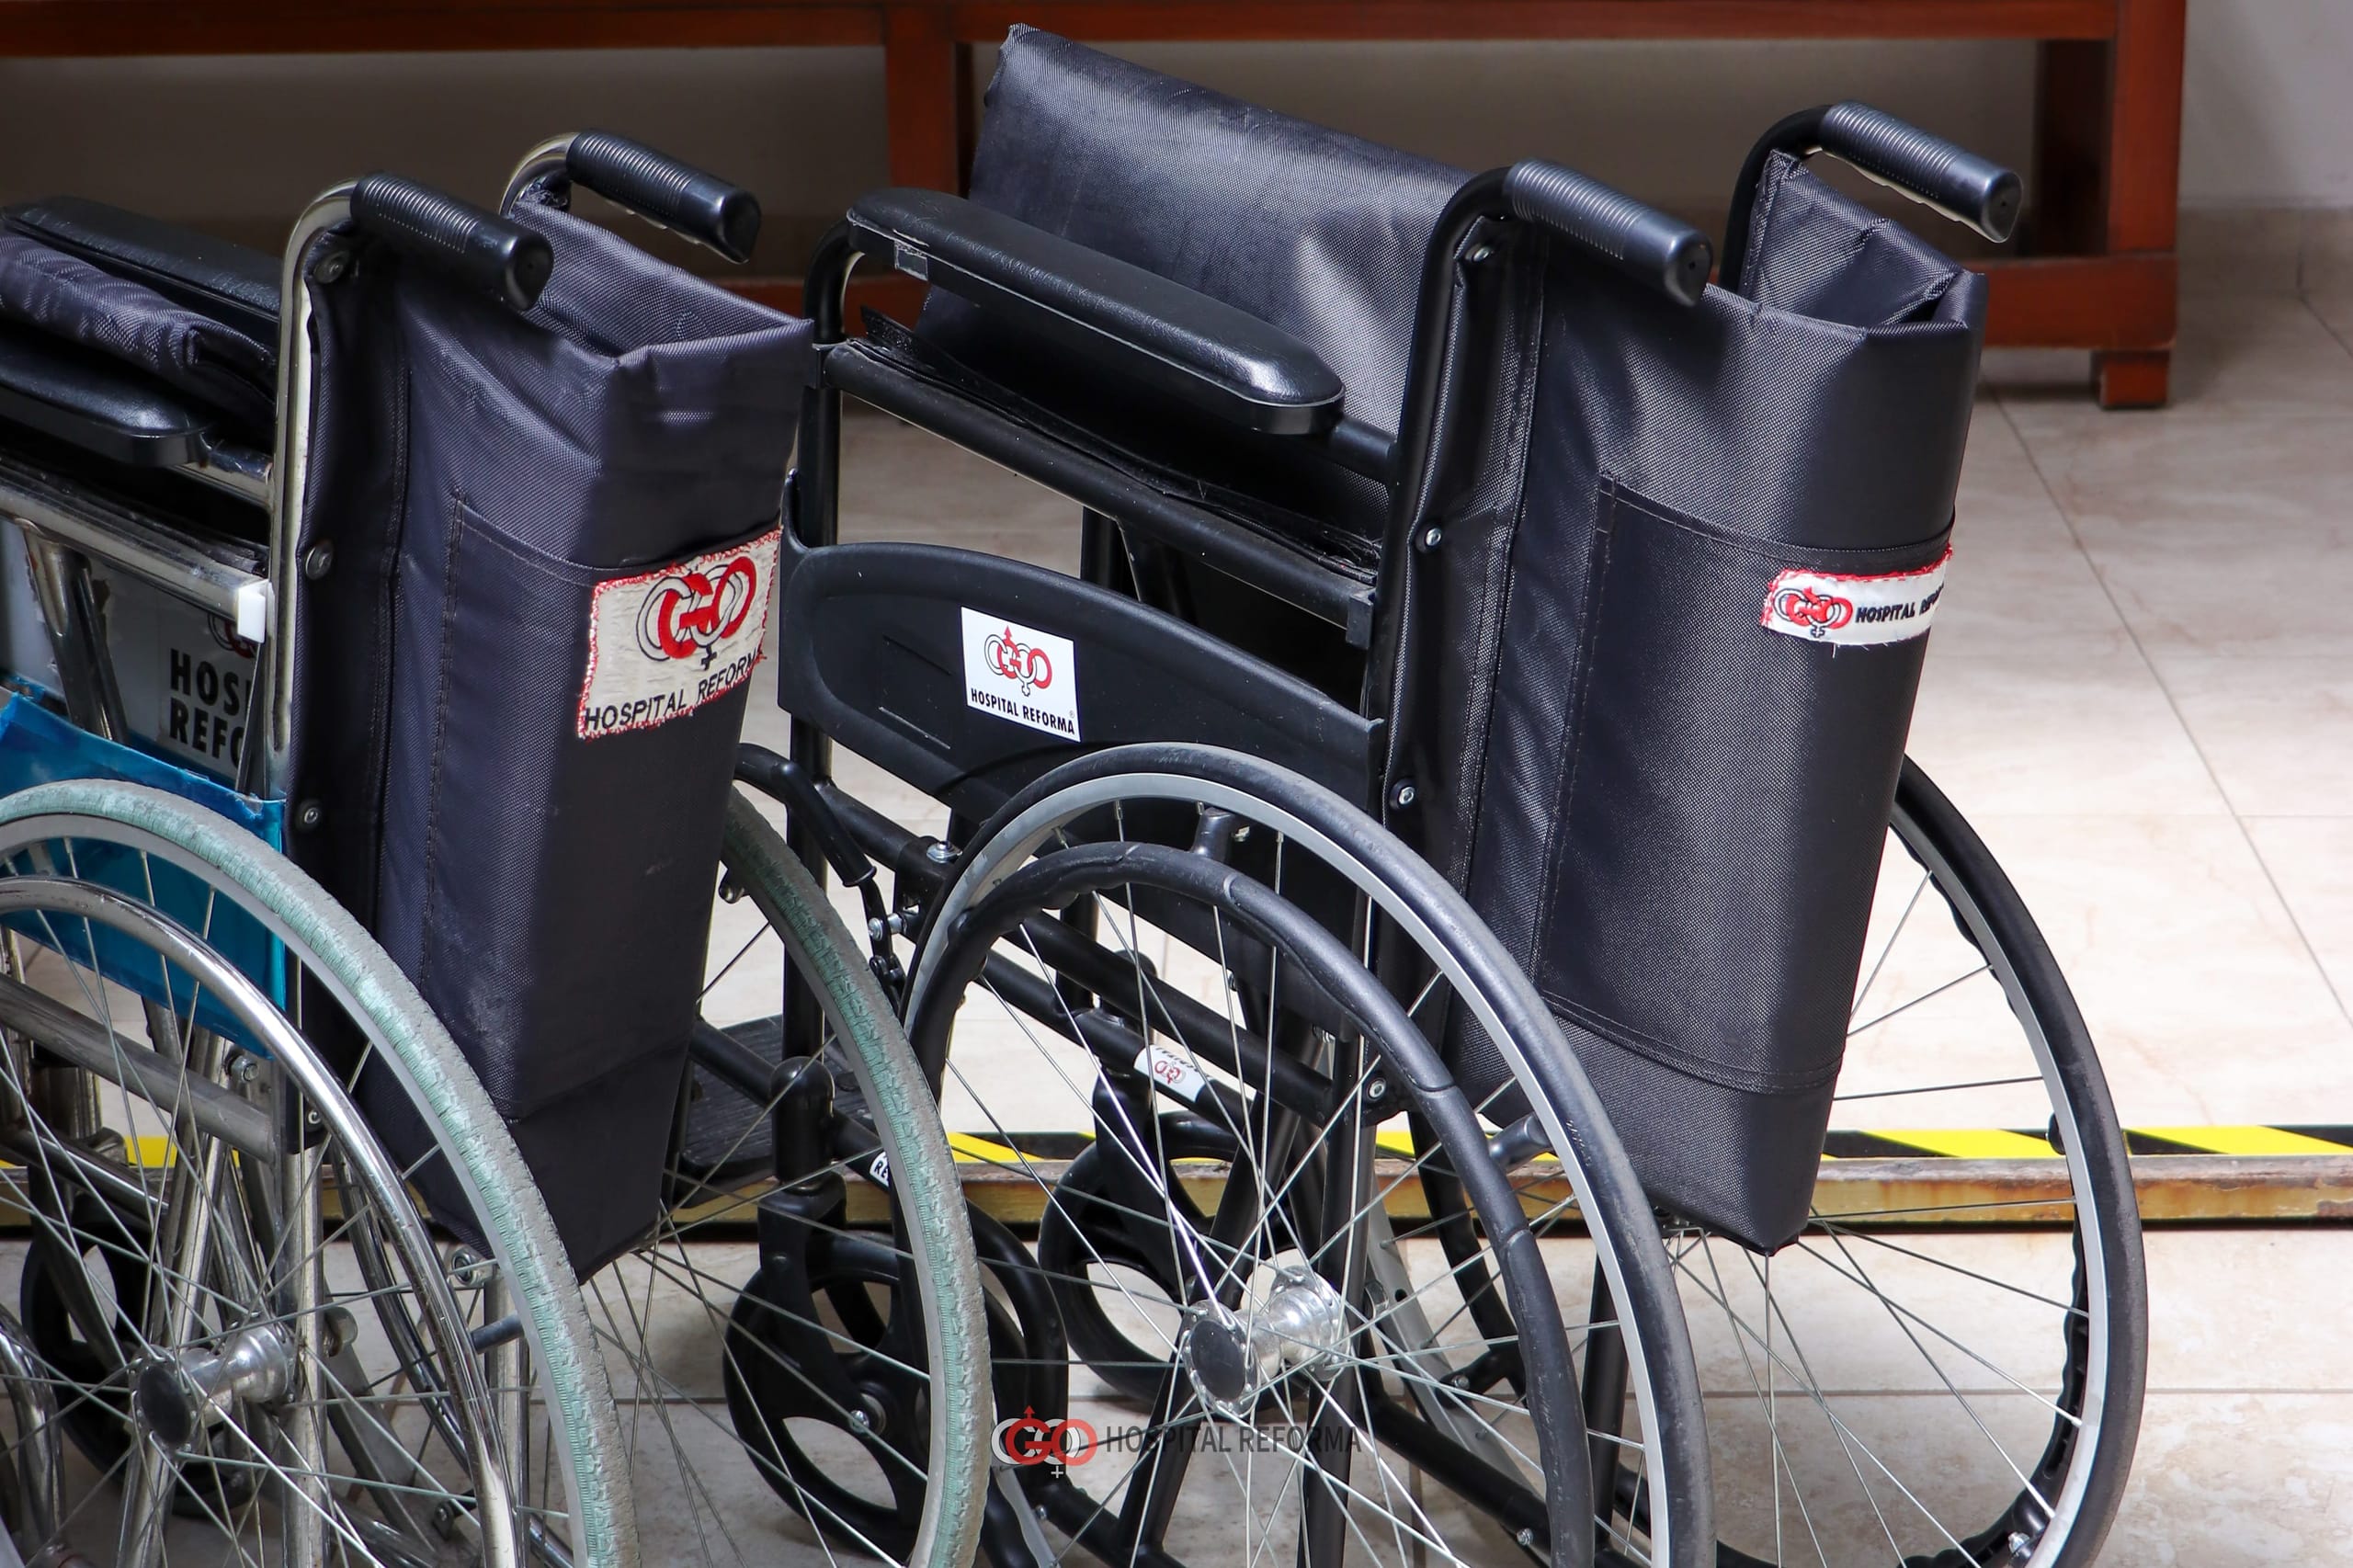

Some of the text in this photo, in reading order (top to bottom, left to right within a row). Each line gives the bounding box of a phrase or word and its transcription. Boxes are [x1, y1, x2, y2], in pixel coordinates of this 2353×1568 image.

[1855, 602, 1915, 623] HOSPITAL
[585, 688, 687, 731] HOSPITAL
[971, 687, 1075, 735] HOSPITAL REFORMA
